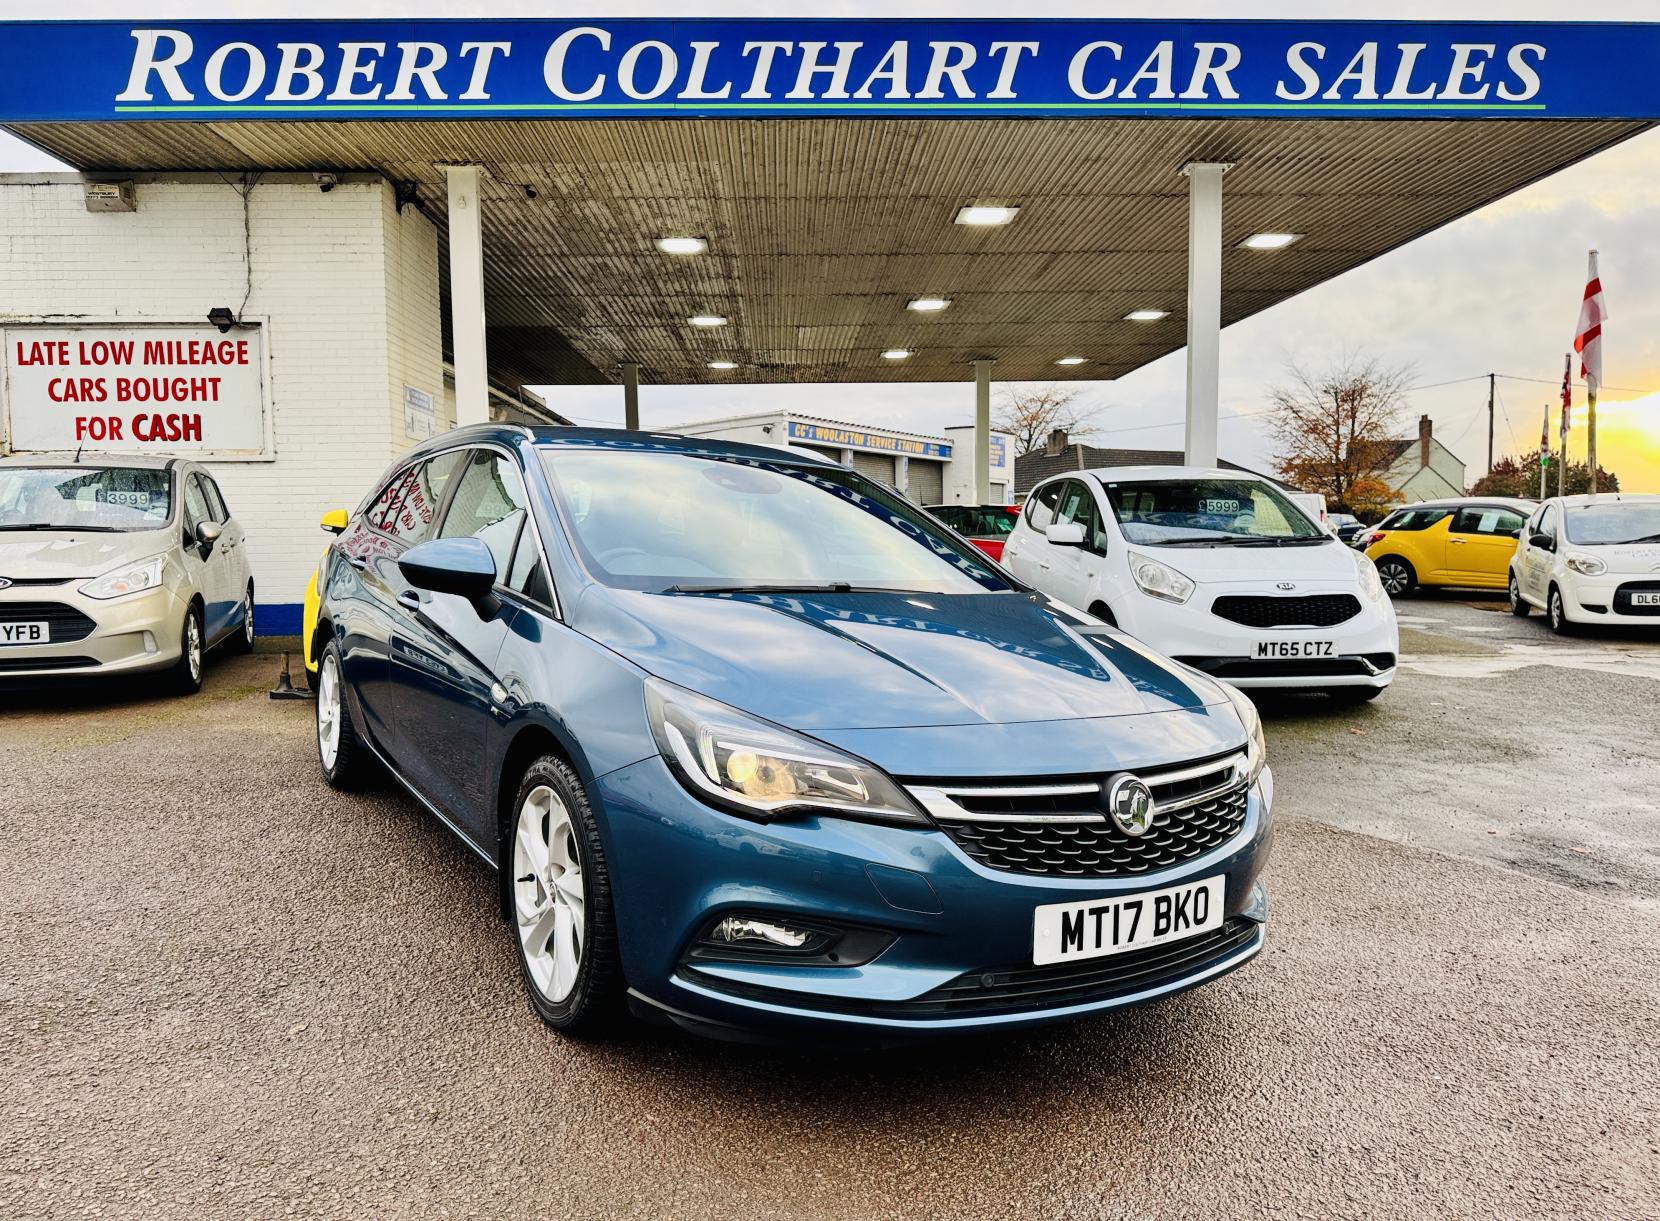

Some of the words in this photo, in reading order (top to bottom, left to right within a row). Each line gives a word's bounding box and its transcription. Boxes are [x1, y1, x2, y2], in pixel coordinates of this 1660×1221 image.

[116, 28, 511, 103] ROBERT
[544, 26, 1039, 102] COLTHART
[1068, 40, 1240, 101] CAR
[1276, 42, 1546, 102] SALES
[17, 341, 69, 366] LATE
[79, 341, 134, 366] LOW
[144, 340, 249, 365] MILEAGE
[48, 377, 108, 402] CARS
[116, 377, 221, 402] BOUGHT
[76, 416, 123, 441] FOR
[131, 413, 202, 441] CASH
[816, 426, 864, 446] WOOLASTON
[867, 435, 896, 450] SERVICE
[897, 439, 924, 454] STATION
[1278, 582, 1295, 590] KIA
[1638, 594, 1660, 604] DL6
[3, 624, 41, 641] YFB
[1257, 642, 1300, 657] MT65
[1303, 641, 1333, 656] CTZ
[1061, 899, 1144, 954] MT17
[1153, 885, 1209, 937] BKO
